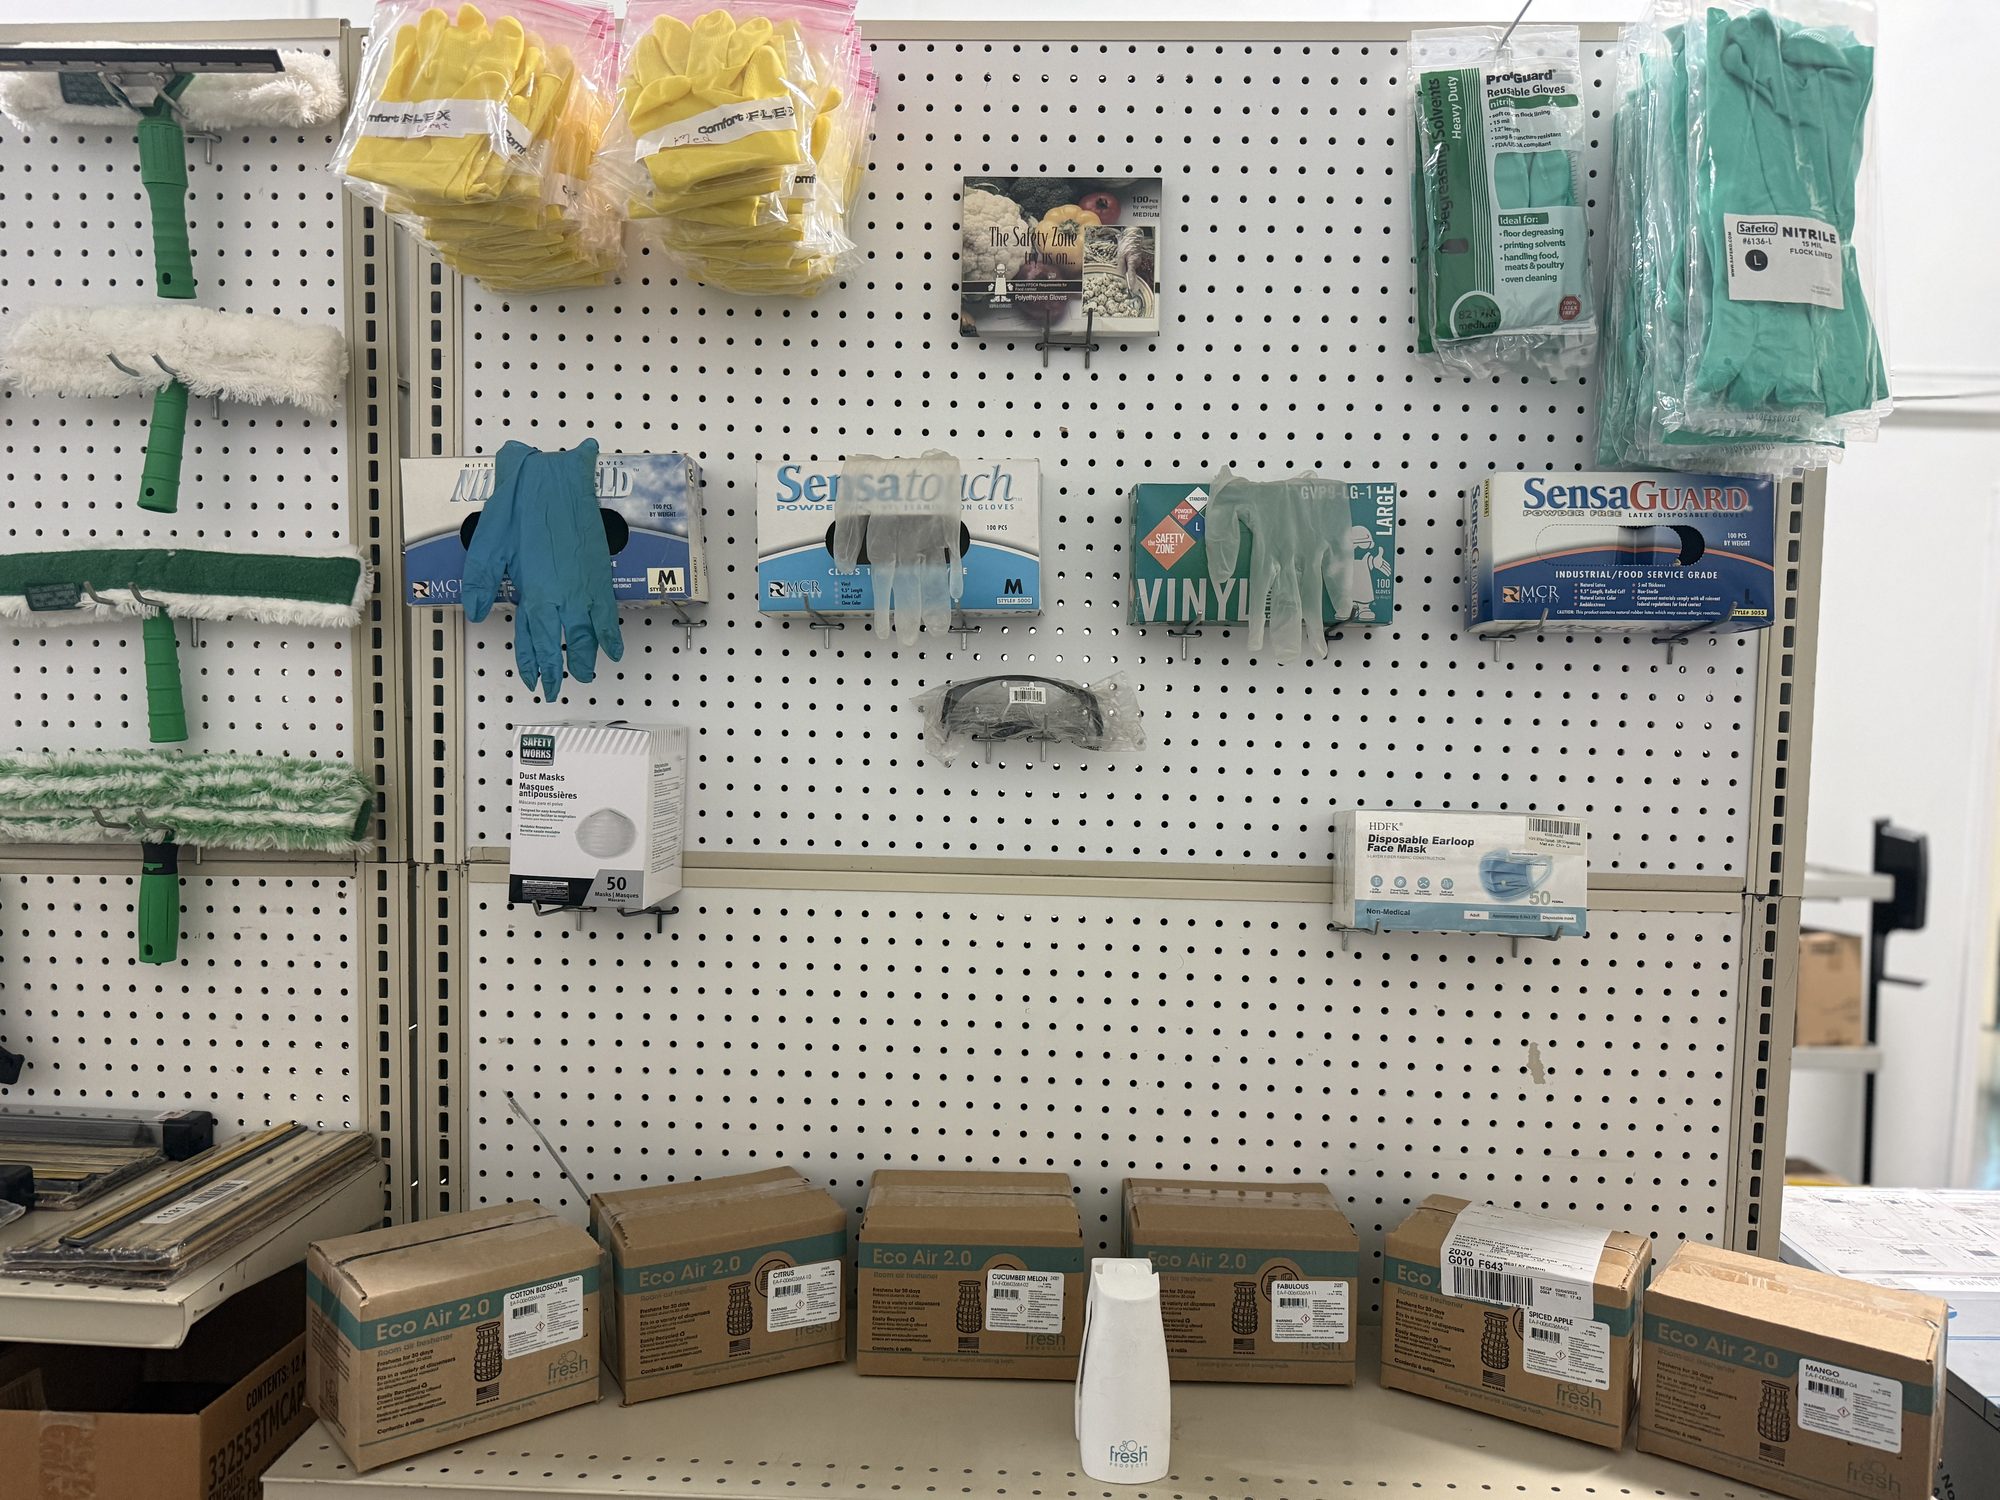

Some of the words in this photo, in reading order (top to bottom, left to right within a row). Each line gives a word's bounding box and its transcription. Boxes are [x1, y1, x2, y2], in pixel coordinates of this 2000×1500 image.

[1448, 76, 1459, 102] Duty
[1487, 87, 1530, 98] Reusable
[1532, 84, 1566, 94] Gloves
[367, 113, 399, 123] mfort
[401, 110, 451, 124] FLEX
[698, 113, 745, 134] Comfort
[1451, 103, 1462, 140] Heavy
[1132, 195, 1149, 204] 100
[1500, 215, 1522, 225] Ideal
[1523, 215, 1539, 225] for:
[1503, 229, 1521, 237] floor
[1521, 227, 1564, 239] degreasing
[1739, 223, 1775, 233] Safeko
[989, 226, 1009, 248] The
[1012, 226, 1049, 249] Safety
[1051, 226, 1078, 248] Zone
[1782, 226, 1837, 244] NITRILE
[1503, 241, 1534, 251] printing
[1534, 238, 1566, 248] solvents
[1504, 252, 1537, 263] handling
[1538, 251, 1559, 261] food,
[1753, 255, 1762, 266] L
[1789, 248, 1814, 257] FLOCK
[1815, 250, 1833, 260] LINED
[1504, 263, 1528, 272] meats
[1529, 262, 1535, 270] &
[1536, 260, 1565, 272] poultry
[1505, 275, 1524, 283] oven
[1524, 273, 1558, 284] cleaning
[1014, 294, 1048, 302] Polyethylene
[777, 504, 834, 512] POWDE
[1375, 485, 1394, 536] LARGE
[1522, 510, 1585, 518] POWDER
[1155, 533, 1185, 544] SAFETY
[1727, 532, 1737, 540] 100
[1738, 532, 1747, 540] PCS
[1155, 543, 1176, 554] ZONE
[657, 569, 677, 585] M
[1555, 570, 1643, 580] INDUSTRIAL/FOOD
[1647, 570, 1684, 580] SERVICE
[1687, 571, 1718, 580] GRADE
[786, 580, 821, 593] MCR
[1003, 578, 1023, 595] M
[1376, 578, 1391, 589] 100
[1521, 585, 1558, 599] MCR
[1137, 577, 1250, 622] VINYL
[522, 736, 552, 747] SAFETY
[522, 748, 552, 759] WORKS
[519, 771, 537, 780] Dust
[538, 772, 565, 782] Masks
[519, 782, 554, 792] Masques
[518, 789, 578, 800] antipoussières
[1368, 821, 1399, 831] HDFK
[1367, 833, 1429, 845] Disposable
[1431, 835, 1475, 848] Earloop
[1366, 843, 1394, 852] Face
[1397, 844, 1427, 854] Mask
[606, 876, 627, 891] 50
[594, 890, 612, 898] Masks
[615, 892, 639, 900] Masques
[1528, 890, 1551, 906] 50
[1365, 907, 1411, 917] Non-Medical
[872, 1248, 905, 1265] Eco
[912, 1249, 938, 1266] Air
[943, 1249, 972, 1267] 2.0
[1448, 1247, 1473, 1257] 2030
[1186, 1252, 1213, 1269] Air
[1218, 1252, 1248, 1269] 2.0
[1448, 1255, 1475, 1267] G010
[1478, 1259, 1504, 1272] F643
[639, 1269, 675, 1288] Eco
[681, 1262, 707, 1281] Air
[711, 1255, 741, 1275] 2.0
[772, 1269, 795, 1279] CITRUS
[991, 1273, 1026, 1281] CUCUMBER
[1397, 1264, 1432, 1285] Eco
[509, 1287, 535, 1300] COTTON
[536, 1281, 563, 1294] BLOSSOM
[376, 1319, 417, 1342] Eco
[423, 1308, 454, 1330] Air
[458, 1298, 491, 1322] 2.0
[1528, 1310, 1553, 1321] SPICED
[1553, 1316, 1574, 1326] APPLE
[1657, 1322, 1701, 1348] Eco
[1703, 1332, 1737, 1358] Air
[1744, 1345, 1780, 1370] 2.0
[548, 1355, 589, 1381] fresh
[1805, 1363, 1840, 1378] MANGO
[246, 1365, 291, 1412] CONTENTS:
[1556, 1384, 1602, 1411] fresh
[1109, 1445, 1148, 1464] fresh
[1846, 1461, 1901, 1492] fresh
